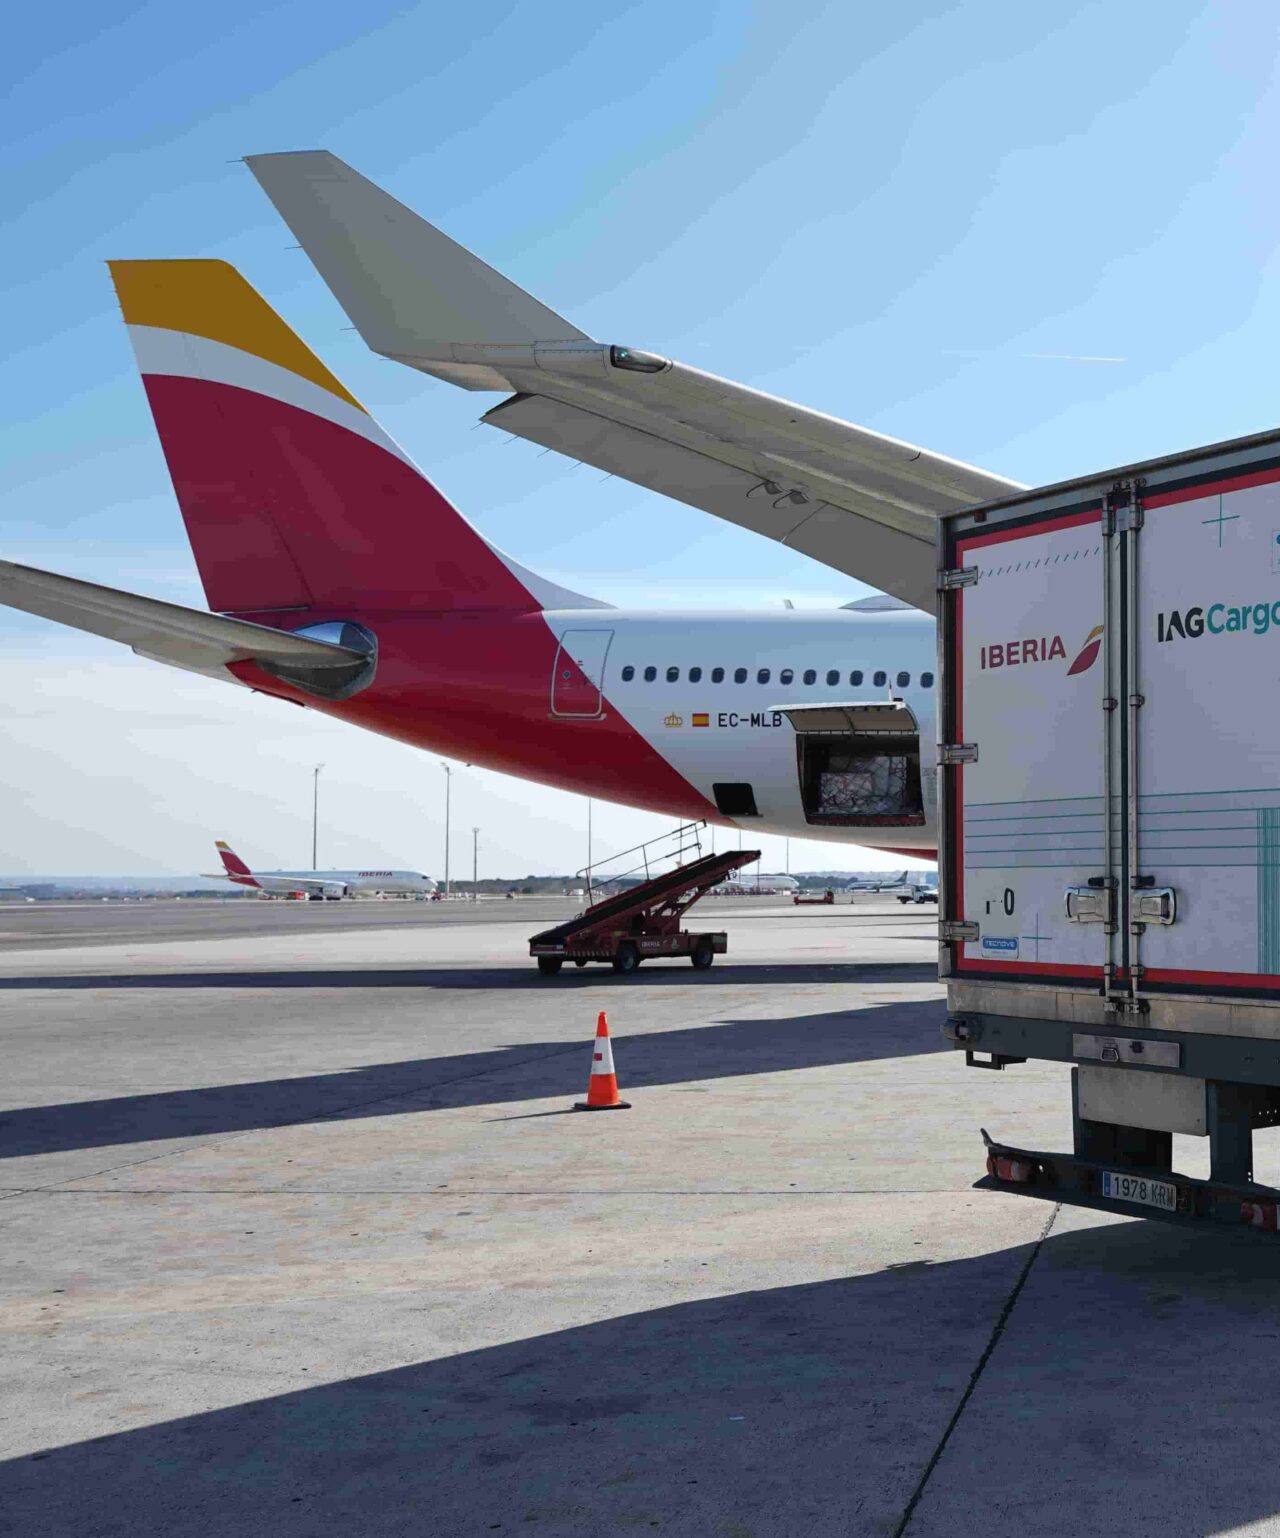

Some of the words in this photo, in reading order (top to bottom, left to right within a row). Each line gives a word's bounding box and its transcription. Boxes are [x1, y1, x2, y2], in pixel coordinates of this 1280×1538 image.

[980, 635, 1067, 670] IBERIA
[718, 712, 782, 727] EC-MLB
[1114, 1176, 1147, 1200] 1978
